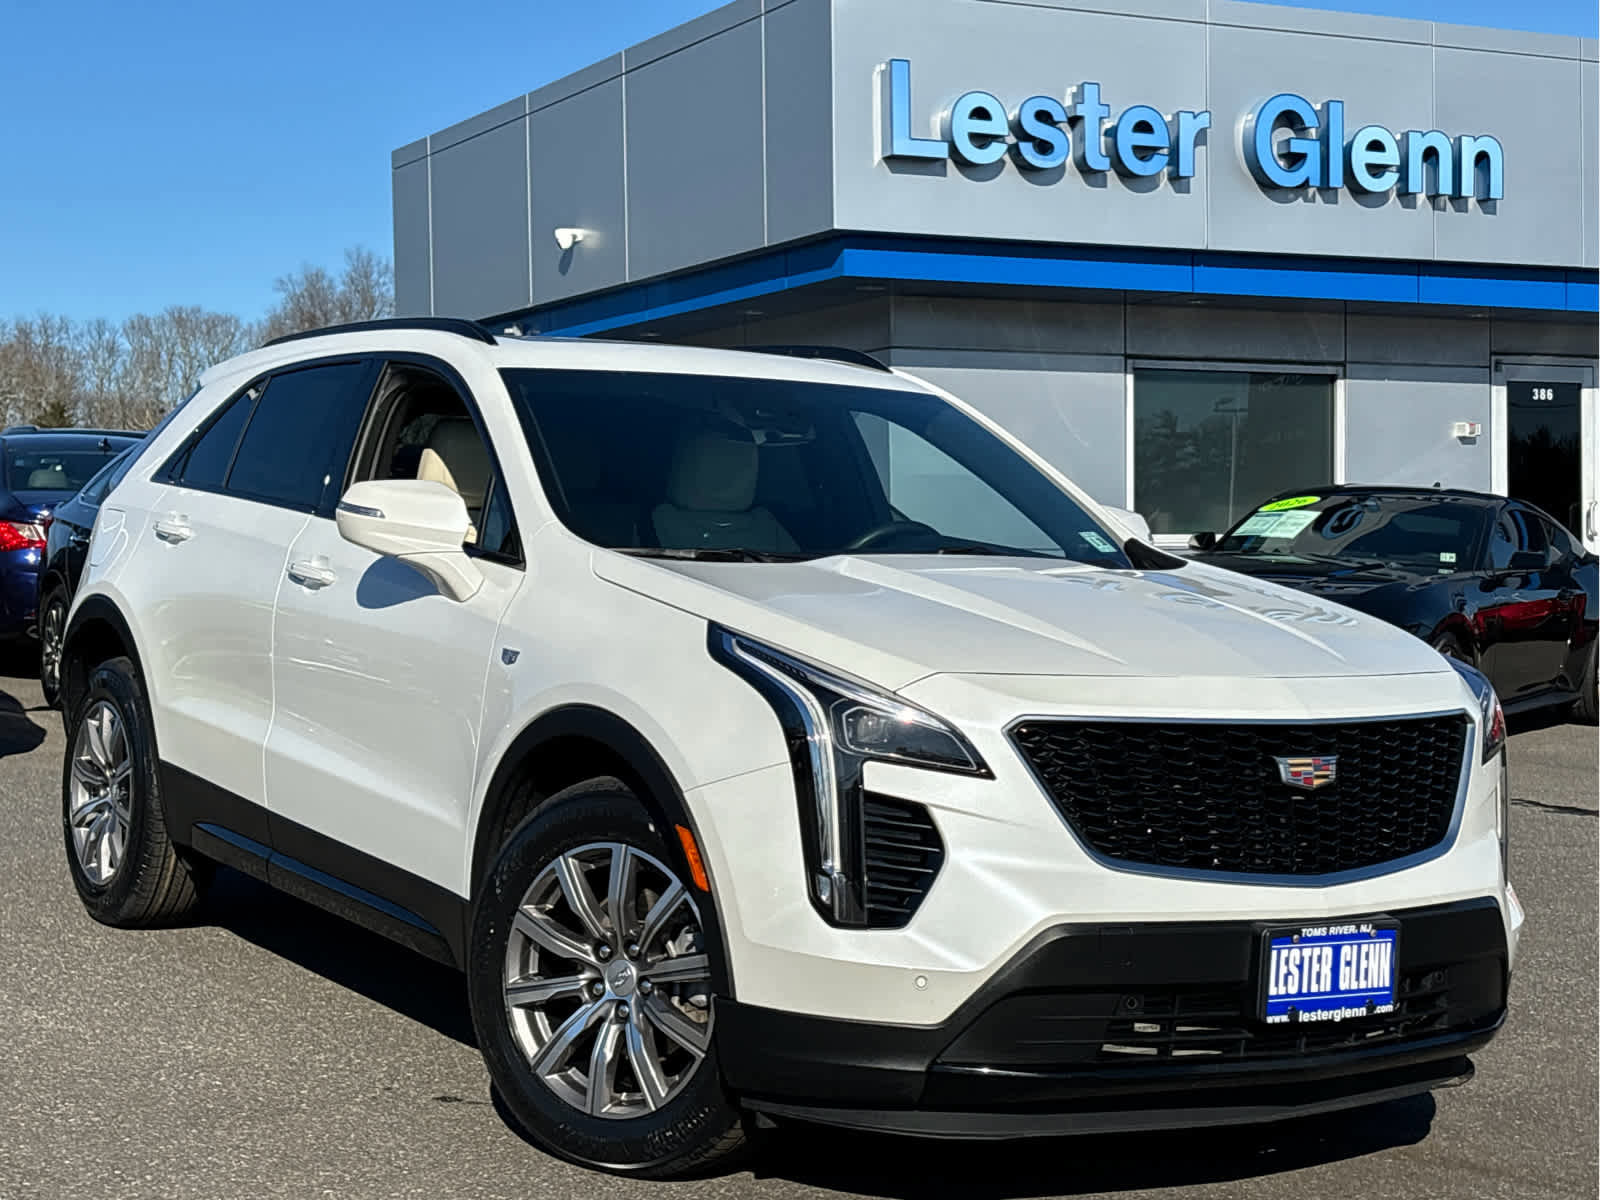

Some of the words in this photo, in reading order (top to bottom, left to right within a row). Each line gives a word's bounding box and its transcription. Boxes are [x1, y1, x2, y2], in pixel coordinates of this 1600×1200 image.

[887, 57, 1211, 178] Lester
[1251, 92, 1505, 202] Glenn
[1532, 388, 1553, 400] 386
[1301, 928, 1327, 938] TOMS
[1360, 924, 1372, 934] NJ
[1269, 947, 1333, 996] LESTER
[1339, 943, 1392, 991] GLENN
